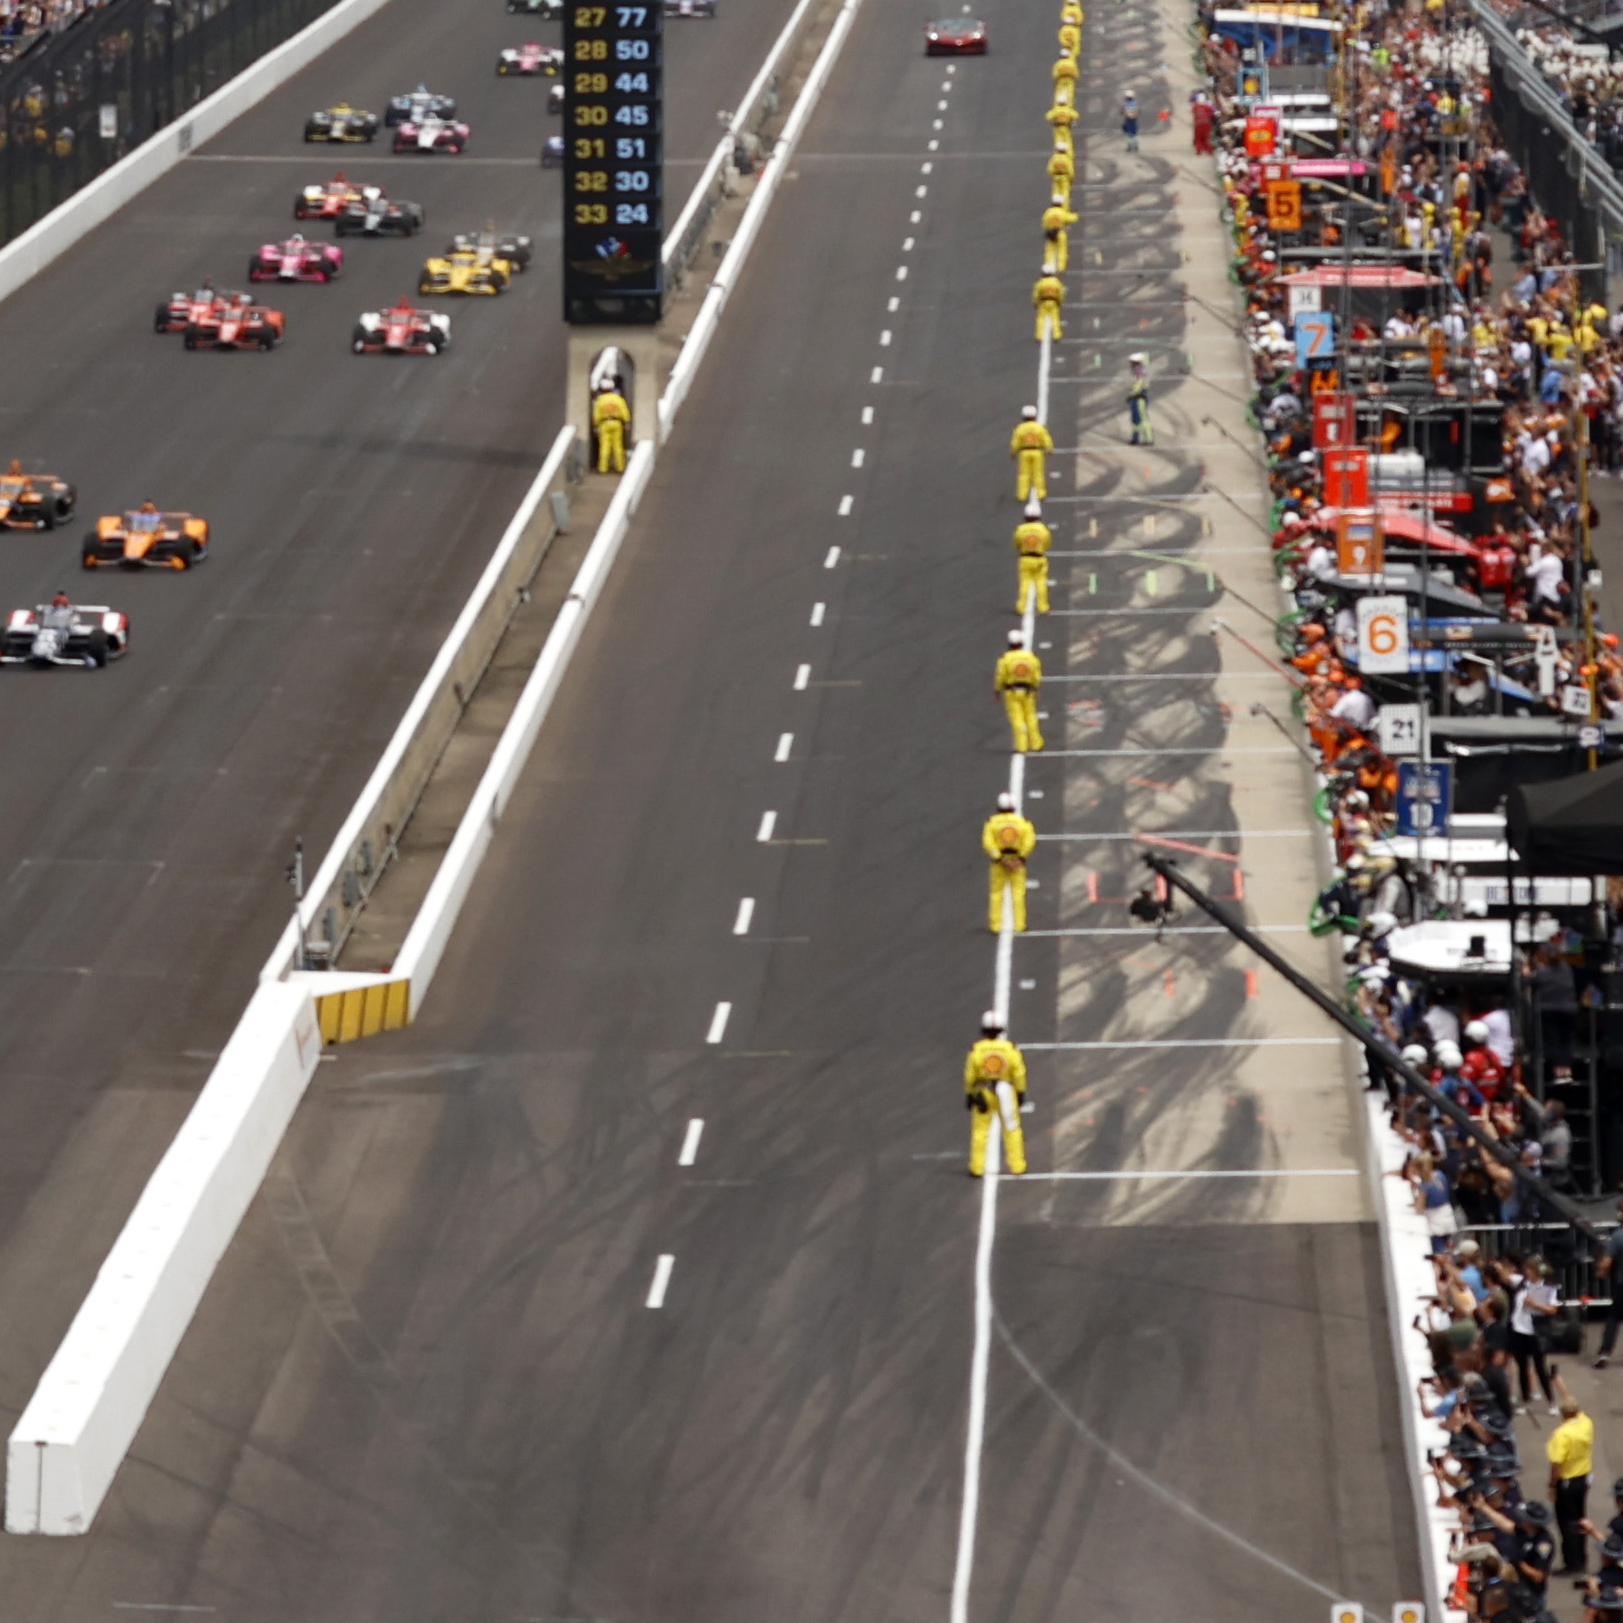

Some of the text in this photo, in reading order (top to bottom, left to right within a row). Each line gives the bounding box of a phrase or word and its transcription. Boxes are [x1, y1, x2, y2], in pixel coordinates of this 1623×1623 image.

[574, 6, 648, 28] 27 77
[575, 39, 650, 61] 28 50
[575, 72, 650, 93] 29 44
[575, 104, 650, 126] 30 45
[575, 137, 646, 159] 31 51
[575, 170, 650, 192] 32 30
[575, 203, 650, 225] 33 24
[1278, 191, 1293, 216] 5
[1303, 323, 1328, 355] 7
[1368, 614, 1398, 655] 6
[1392, 720, 1414, 739] 21
